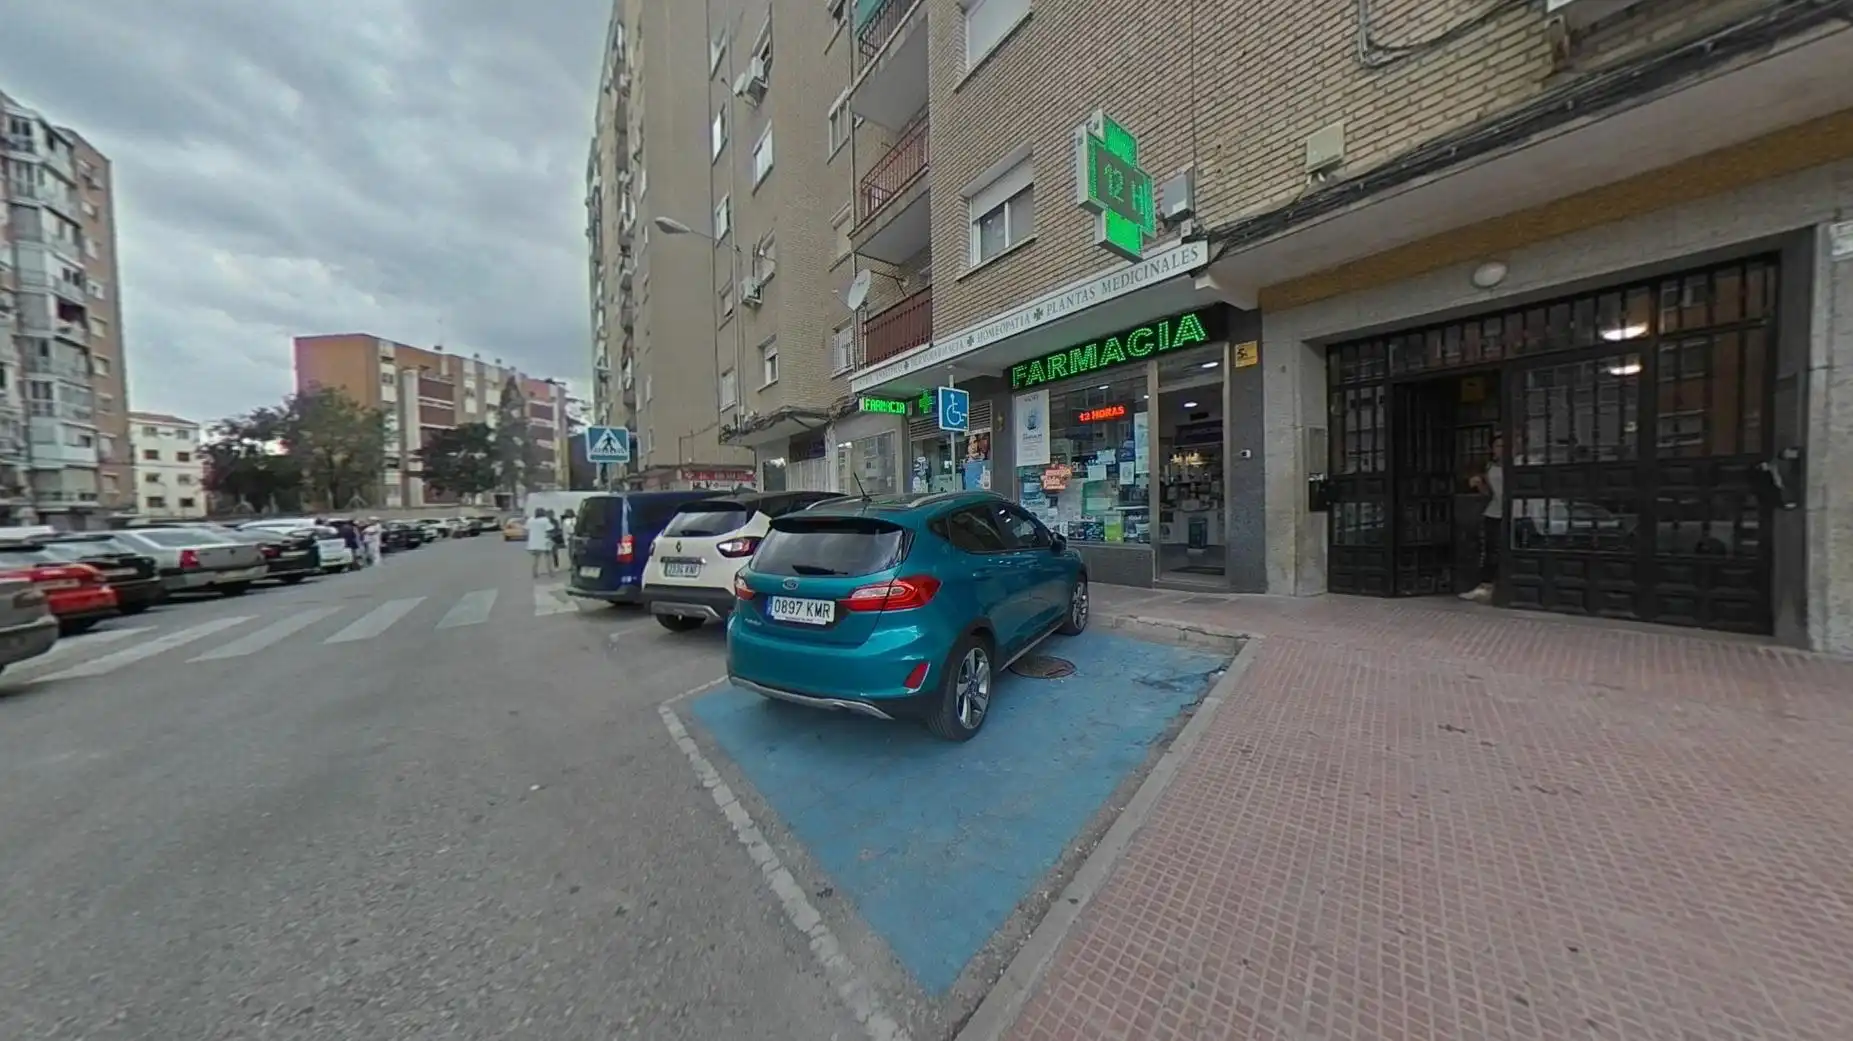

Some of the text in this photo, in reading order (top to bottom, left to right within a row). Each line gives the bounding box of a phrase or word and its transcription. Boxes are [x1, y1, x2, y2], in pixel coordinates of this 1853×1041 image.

[1104, 163, 1145, 215] 12 H
[977, 312, 1031, 342] HOMEOPATIA
[1046, 287, 1096, 316] PLANTAS
[1101, 246, 1199, 295] MEDICINALES
[1011, 312, 1209, 389] FARMACIA
[864, 399, 905, 414] FARMACIA
[1092, 406, 1125, 419] HORAS
[774, 599, 831, 619] 0897 KMR
